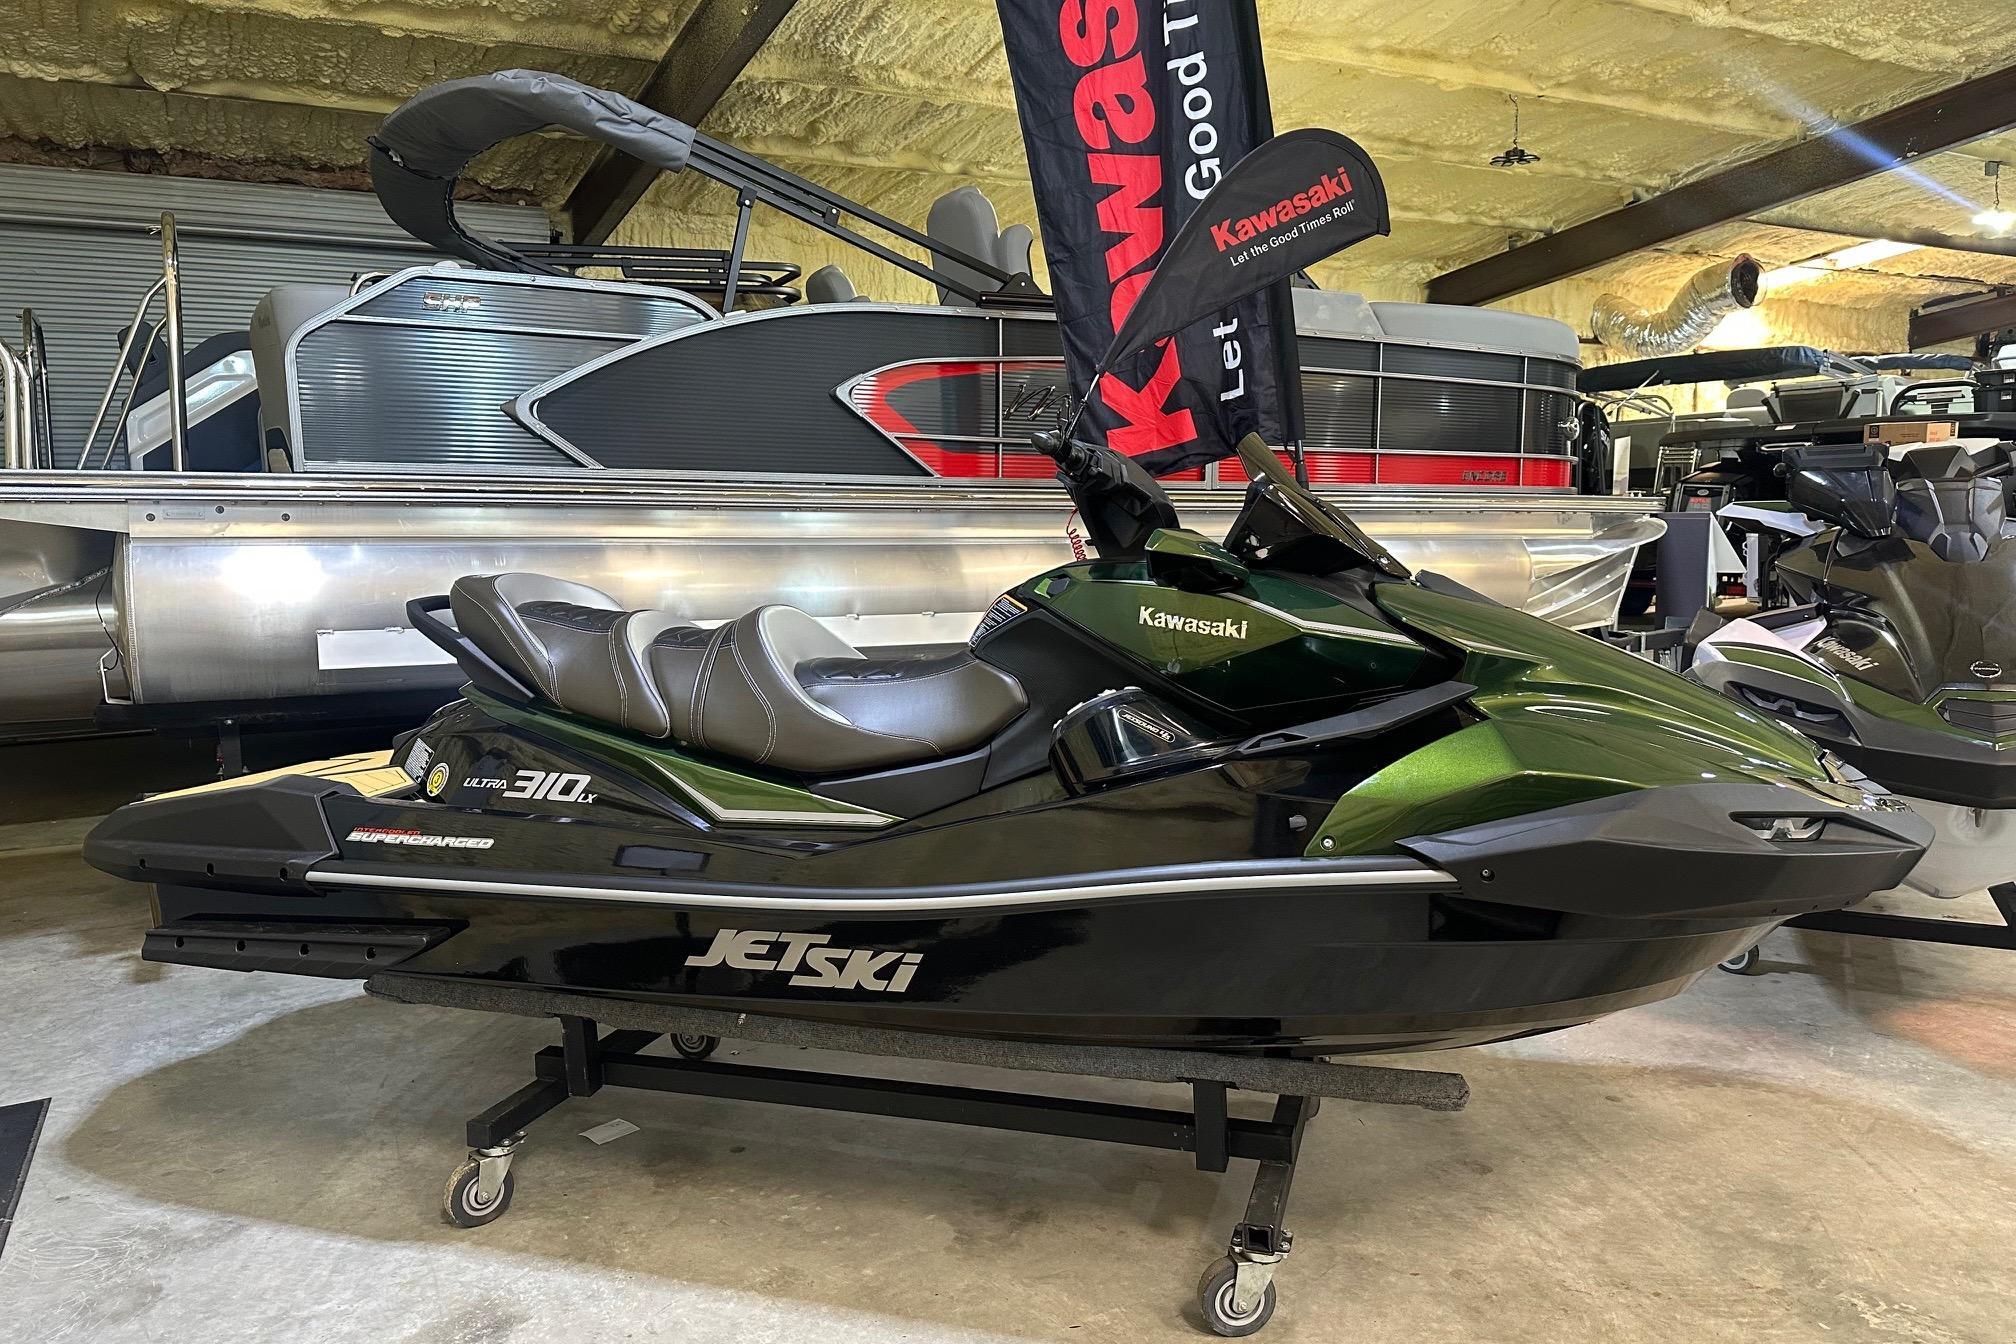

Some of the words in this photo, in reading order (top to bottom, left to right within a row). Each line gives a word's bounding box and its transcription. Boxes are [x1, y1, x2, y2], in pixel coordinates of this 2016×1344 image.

[1167, 51, 1222, 200] Good
[1210, 166, 1353, 252] Kawasaki
[1230, 249, 1251, 267] Let
[1250, 243, 1269, 258] the
[1269, 227, 1299, 248] Good
[1299, 212, 1332, 234] Times
[1213, 317, 1245, 402] Let
[1139, 606, 1248, 640] Kawasaki
[1813, 635, 1880, 672] Kawasaki
[463, 777, 507, 790] ULTRA
[345, 831, 495, 850] SUPERCHARGED
